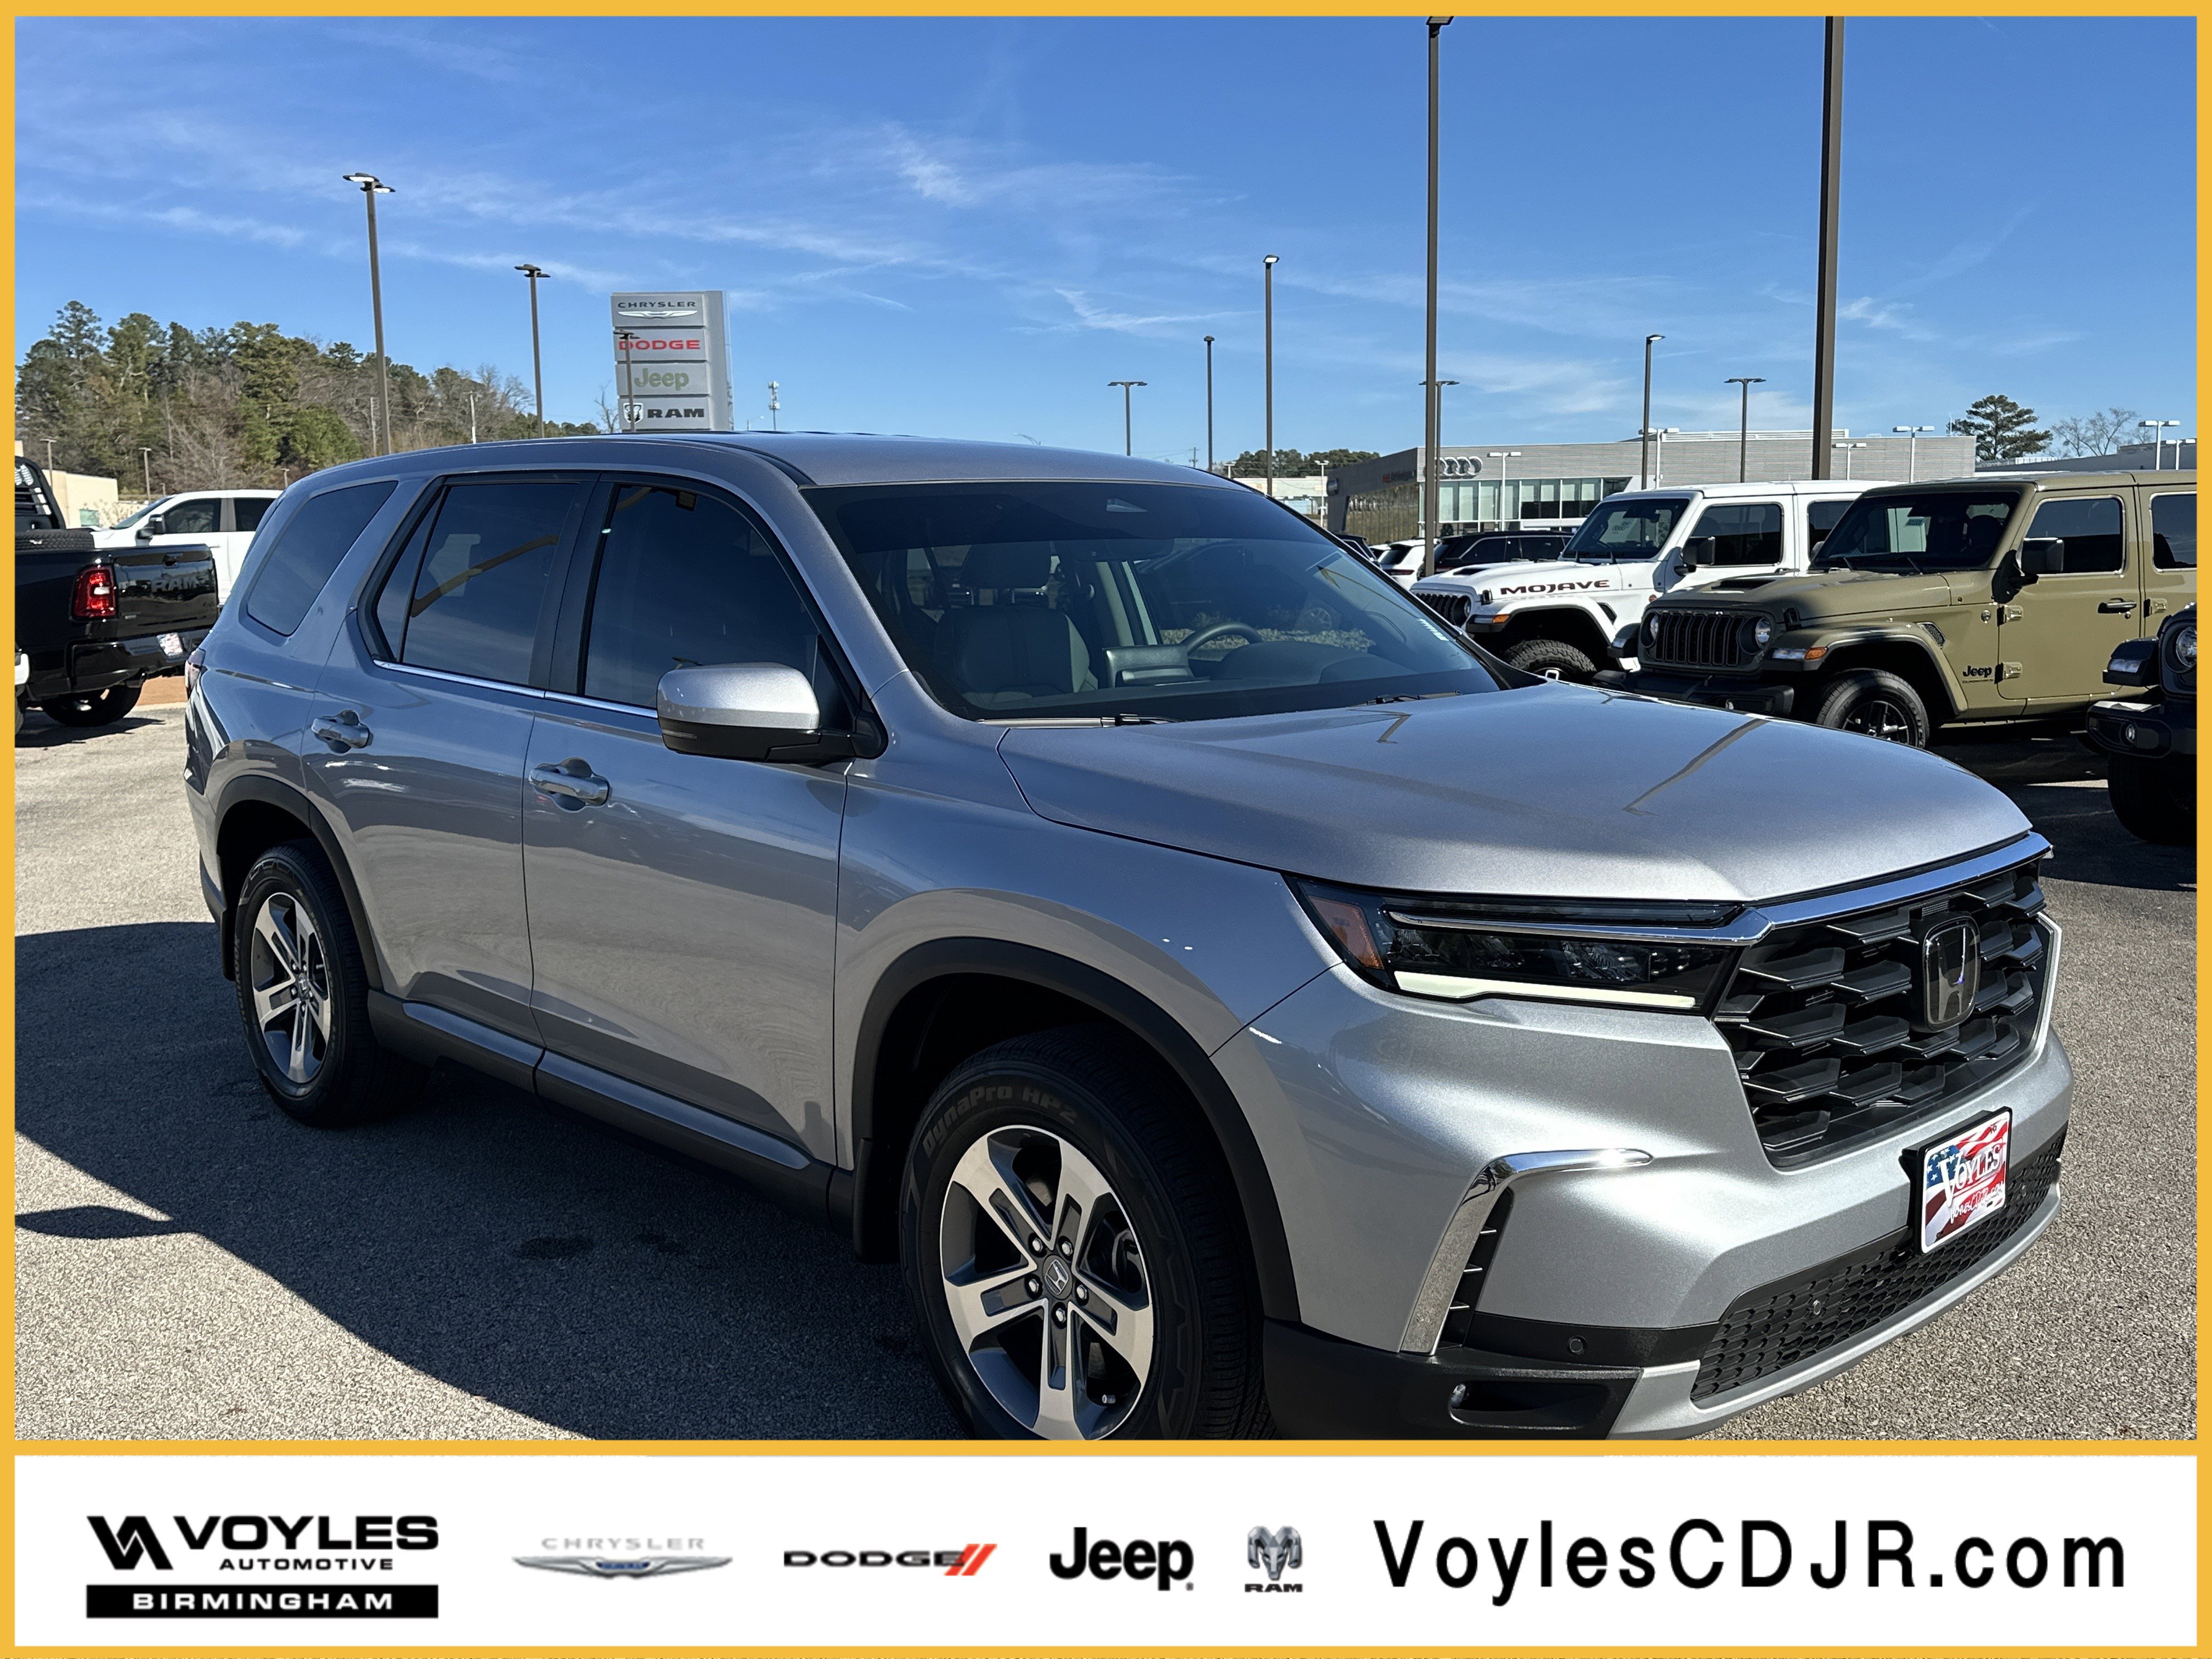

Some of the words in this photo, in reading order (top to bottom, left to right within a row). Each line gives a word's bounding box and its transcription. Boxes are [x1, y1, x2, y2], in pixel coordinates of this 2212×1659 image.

[618, 339, 701, 351] DODGE
[634, 368, 690, 391] Jeep
[647, 408, 705, 419] RAM
[151, 576, 198, 592] RAM
[1500, 579, 1610, 595] MOJAVE
[1962, 665, 1993, 678] Jeep
[1939, 1144, 2001, 1207] VOYLES
